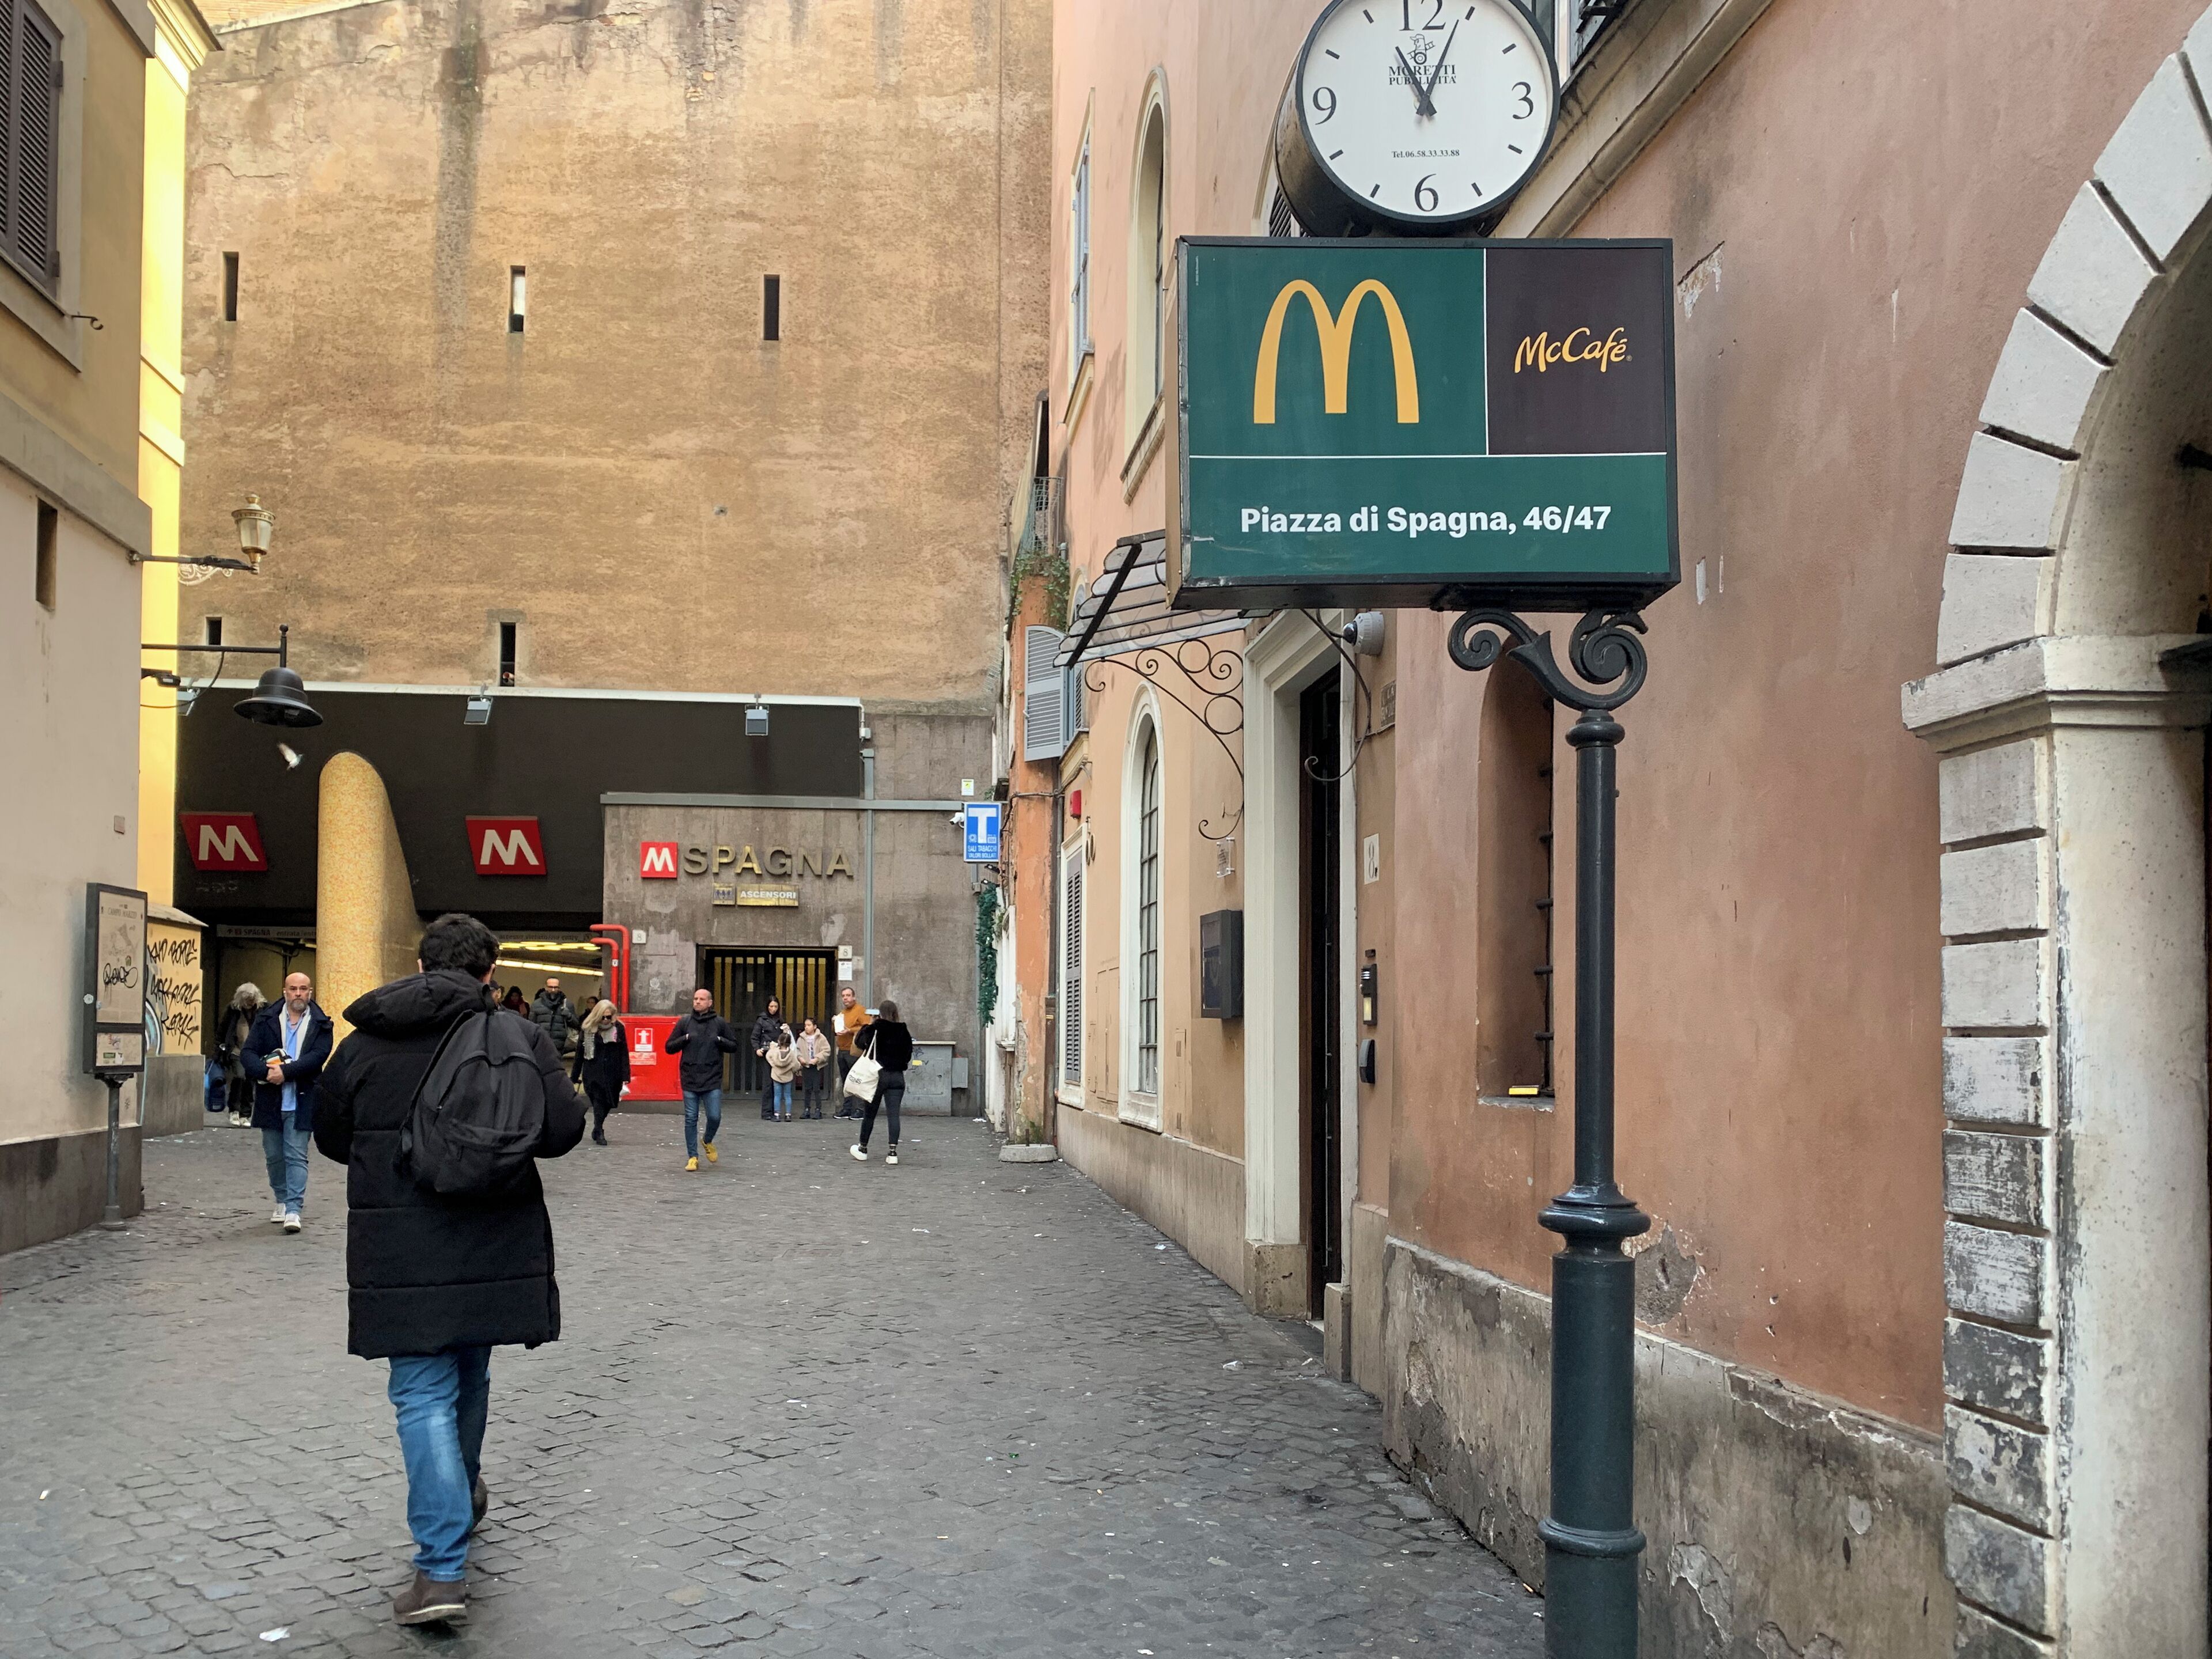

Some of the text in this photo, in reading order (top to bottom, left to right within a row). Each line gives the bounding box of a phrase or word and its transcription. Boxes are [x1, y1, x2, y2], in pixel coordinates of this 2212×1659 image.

[1399, 0, 1445, 31] 12
[1313, 87, 1336, 125] 9
[1512, 82, 1534, 119] 3
[1392, 150, 1460, 158] Tel.06.58.33.33.88
[1414, 173, 1439, 212] 6
[1241, 505, 1611, 538] Piazza di Spagna, 46/47
[968, 808, 997, 843] T
[198, 825, 259, 862] M
[479, 830, 539, 865] M
[684, 844, 854, 876] SPAGNA
[740, 891, 796, 899] ASCENSORI
[637, 933, 642, 941] 8
[843, 948, 849, 956] 8
